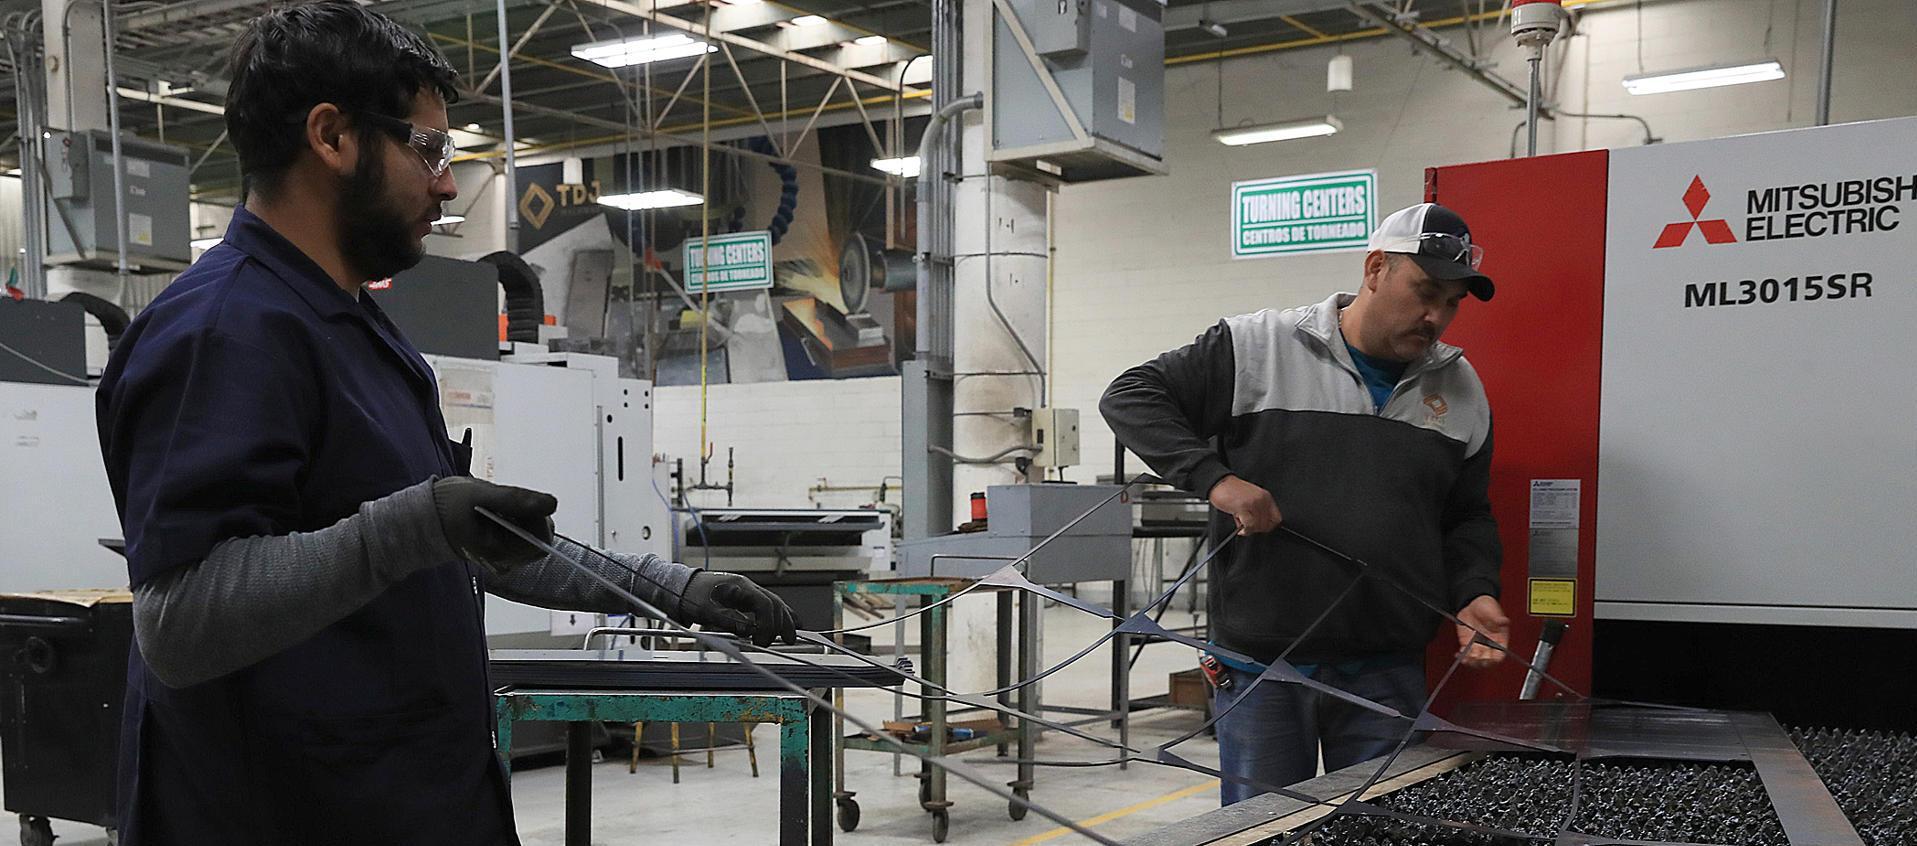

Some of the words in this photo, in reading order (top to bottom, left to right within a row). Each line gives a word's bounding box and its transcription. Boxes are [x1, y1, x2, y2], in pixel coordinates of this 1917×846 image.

[556, 179, 601, 207] TDJ
[1242, 191, 1300, 223] TURNING
[1303, 185, 1365, 218] CENTERS
[1242, 227, 1290, 245] CENTROS
[1291, 226, 1306, 242] DE
[1307, 222, 1366, 240] TORNEADO
[1746, 205, 1900, 242] ELECTRIC
[726, 242, 765, 265] CENTERS
[1685, 272, 1873, 308] ML3015SR
